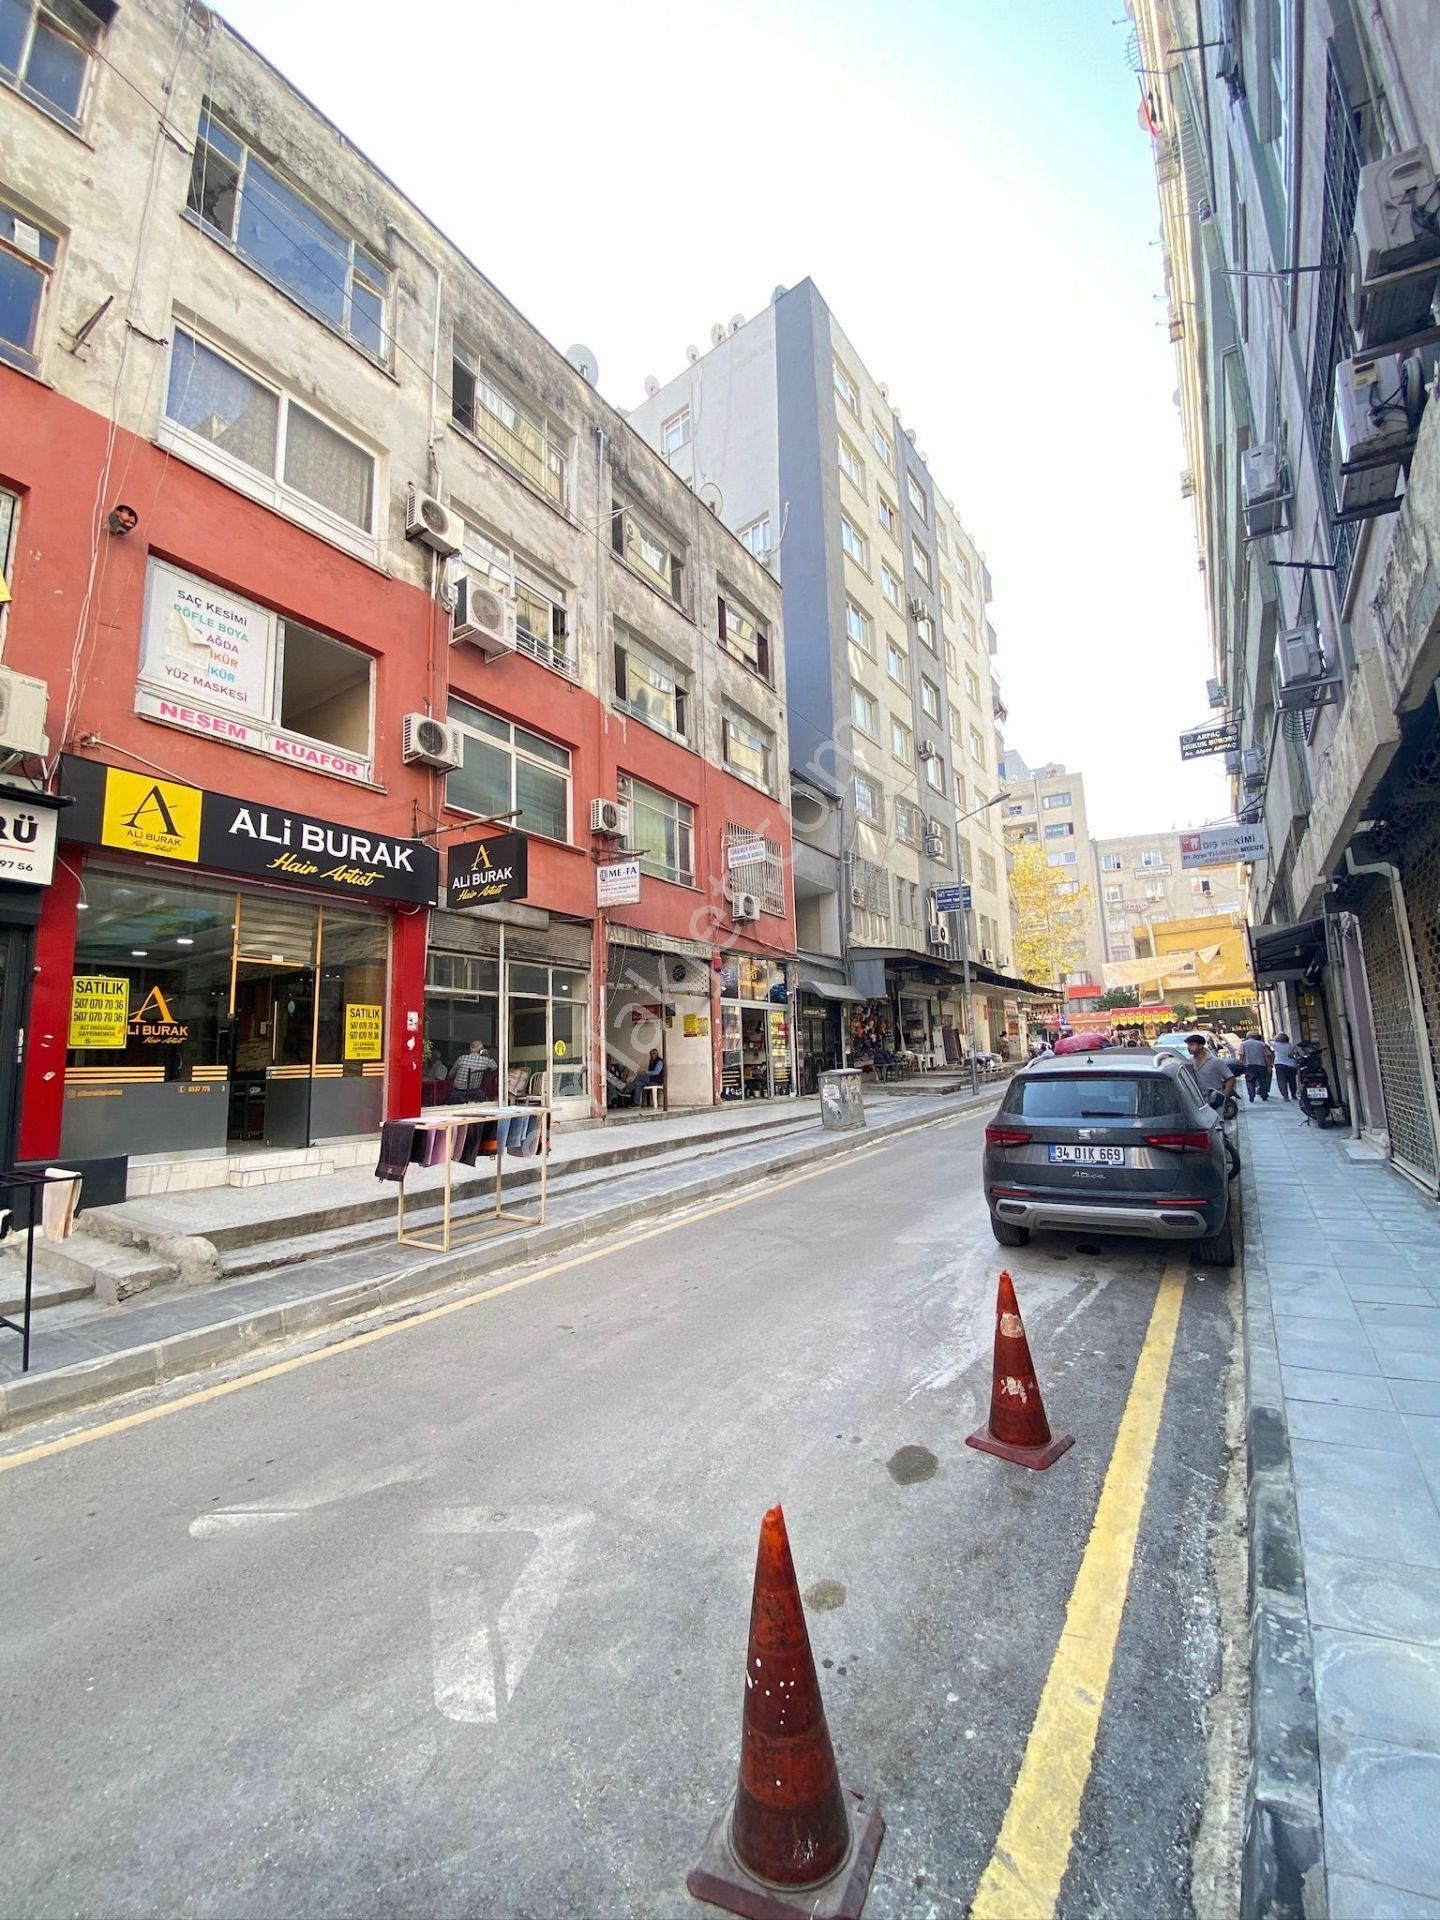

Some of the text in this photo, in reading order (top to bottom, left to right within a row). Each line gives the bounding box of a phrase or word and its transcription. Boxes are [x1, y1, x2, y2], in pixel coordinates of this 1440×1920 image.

[178, 590, 247, 626] SAÇ KESİMİ
[173, 603, 248, 642] RÖFLE BOYA
[206, 634, 239, 654] AĞDA
[165, 665, 248, 702] YÜZ MASKESİ
[160, 702, 358, 776] NEŞEM KUAFÖR
[146, 833, 181, 846] BURAK
[301, 823, 414, 873] BURAK
[17, 863, 33, 872] 56
[266, 852, 385, 887] Hair Artist
[609, 866, 637, 877] ME-FA
[472, 866, 513, 885] BURAK
[76, 980, 124, 995] SATILIK
[74, 998, 124, 1010] 507 070 70 36
[74, 1011, 123, 1023] 507 070 70 36
[350, 1007, 380, 1019] SATILIK
[142, 1025, 188, 1036] BURAK
[1056, 1147, 1069, 1158] 34
[1074, 1147, 1095, 1160] DIK
[1100, 1148, 1120, 1161] 669
